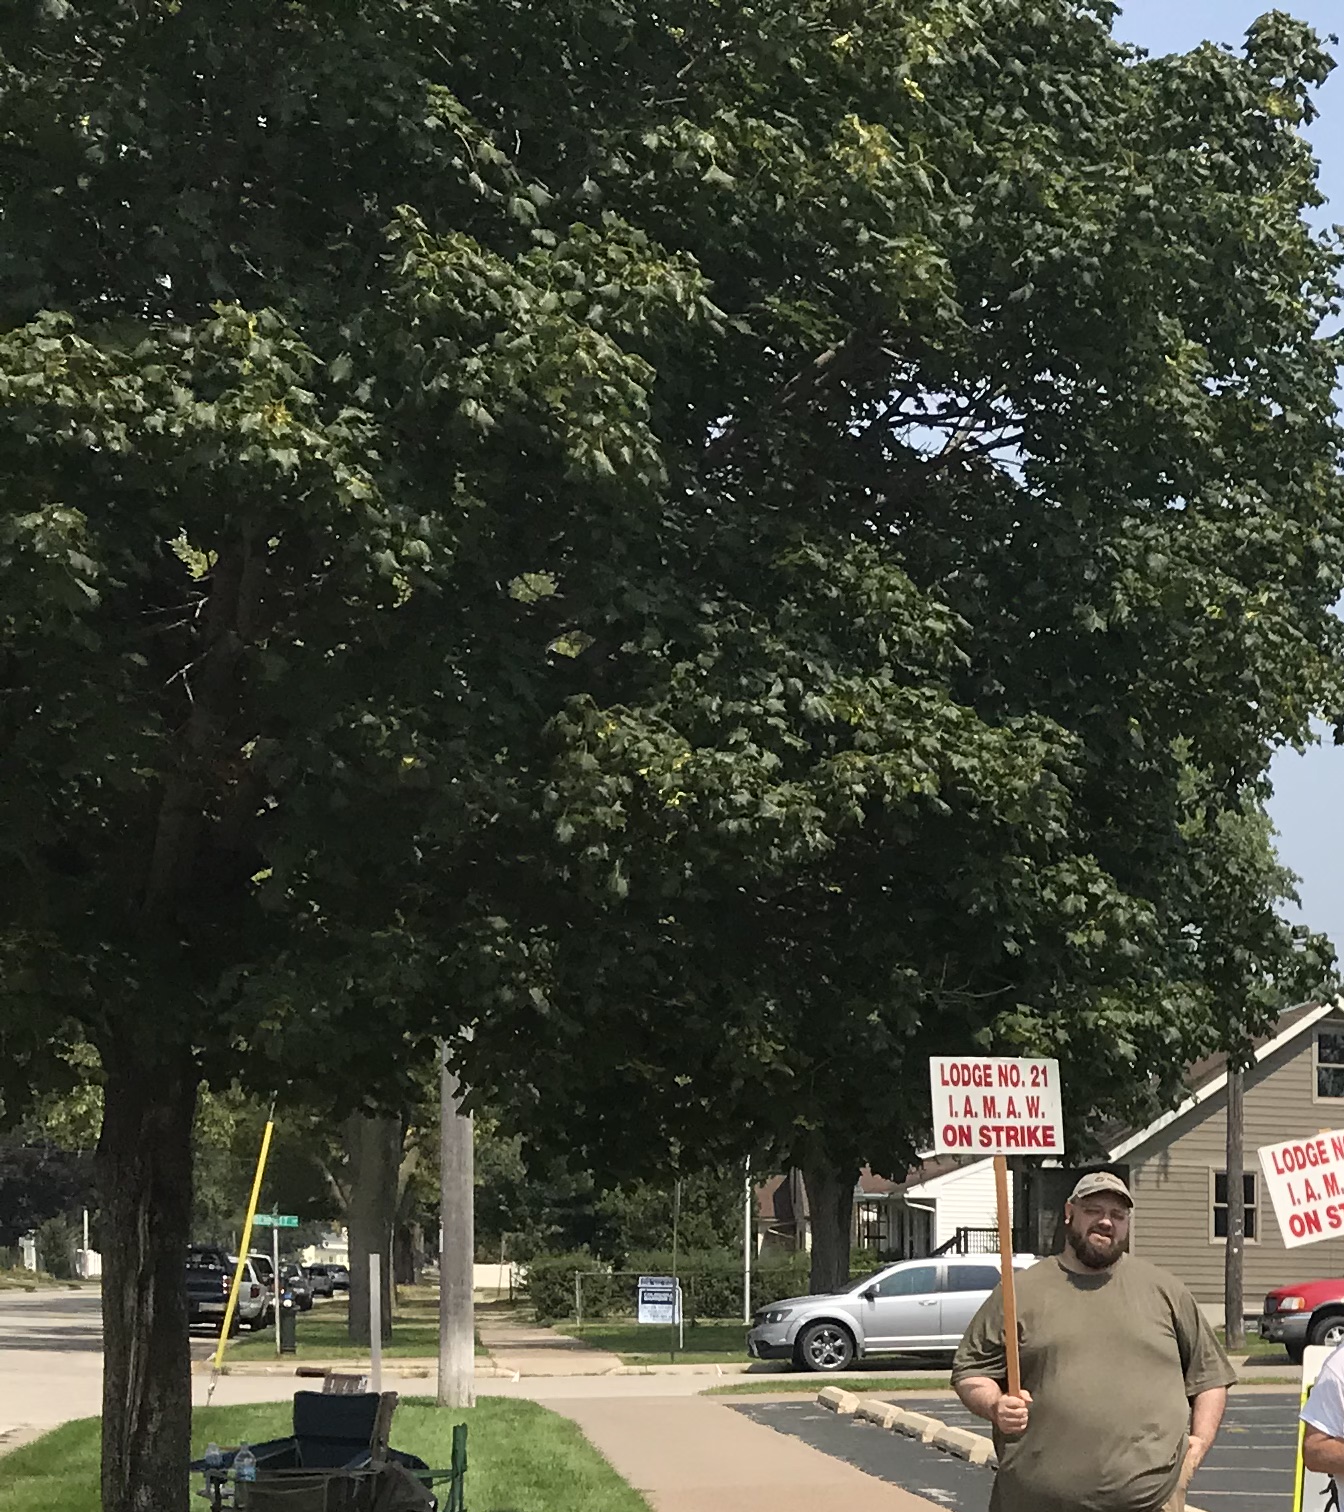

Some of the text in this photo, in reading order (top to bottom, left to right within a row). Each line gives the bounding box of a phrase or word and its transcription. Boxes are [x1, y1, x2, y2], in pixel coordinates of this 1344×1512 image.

[941, 1063, 1048, 1088] LODGE NO. 21
[942, 1124, 1056, 1148] ON STRIKE
[1272, 1140, 1330, 1175] LODGE
[1289, 1209, 1322, 1238] ON
